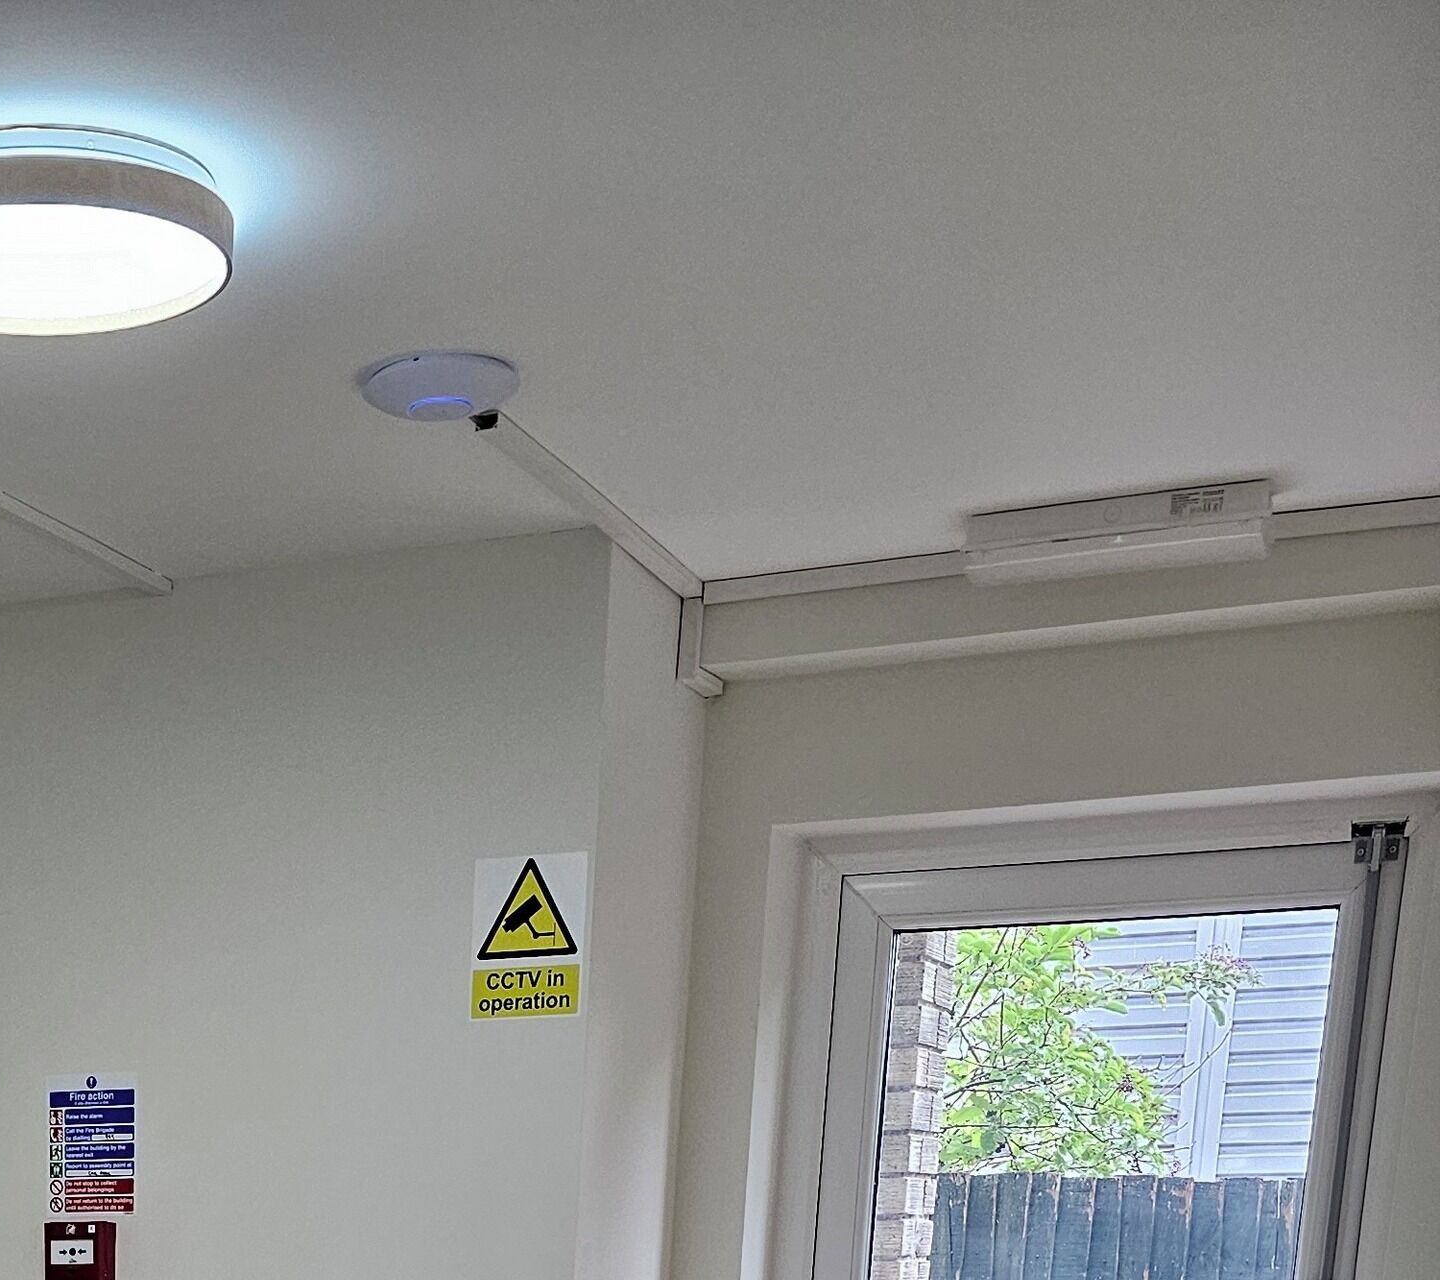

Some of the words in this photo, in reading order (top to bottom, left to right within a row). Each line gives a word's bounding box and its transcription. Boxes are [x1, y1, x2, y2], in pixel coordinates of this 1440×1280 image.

[486, 970, 542, 990] CCTV
[547, 969, 565, 987] in
[478, 992, 570, 1016] operation
[69, 1092, 86, 1101] Fire
[87, 1091, 114, 1100] action
